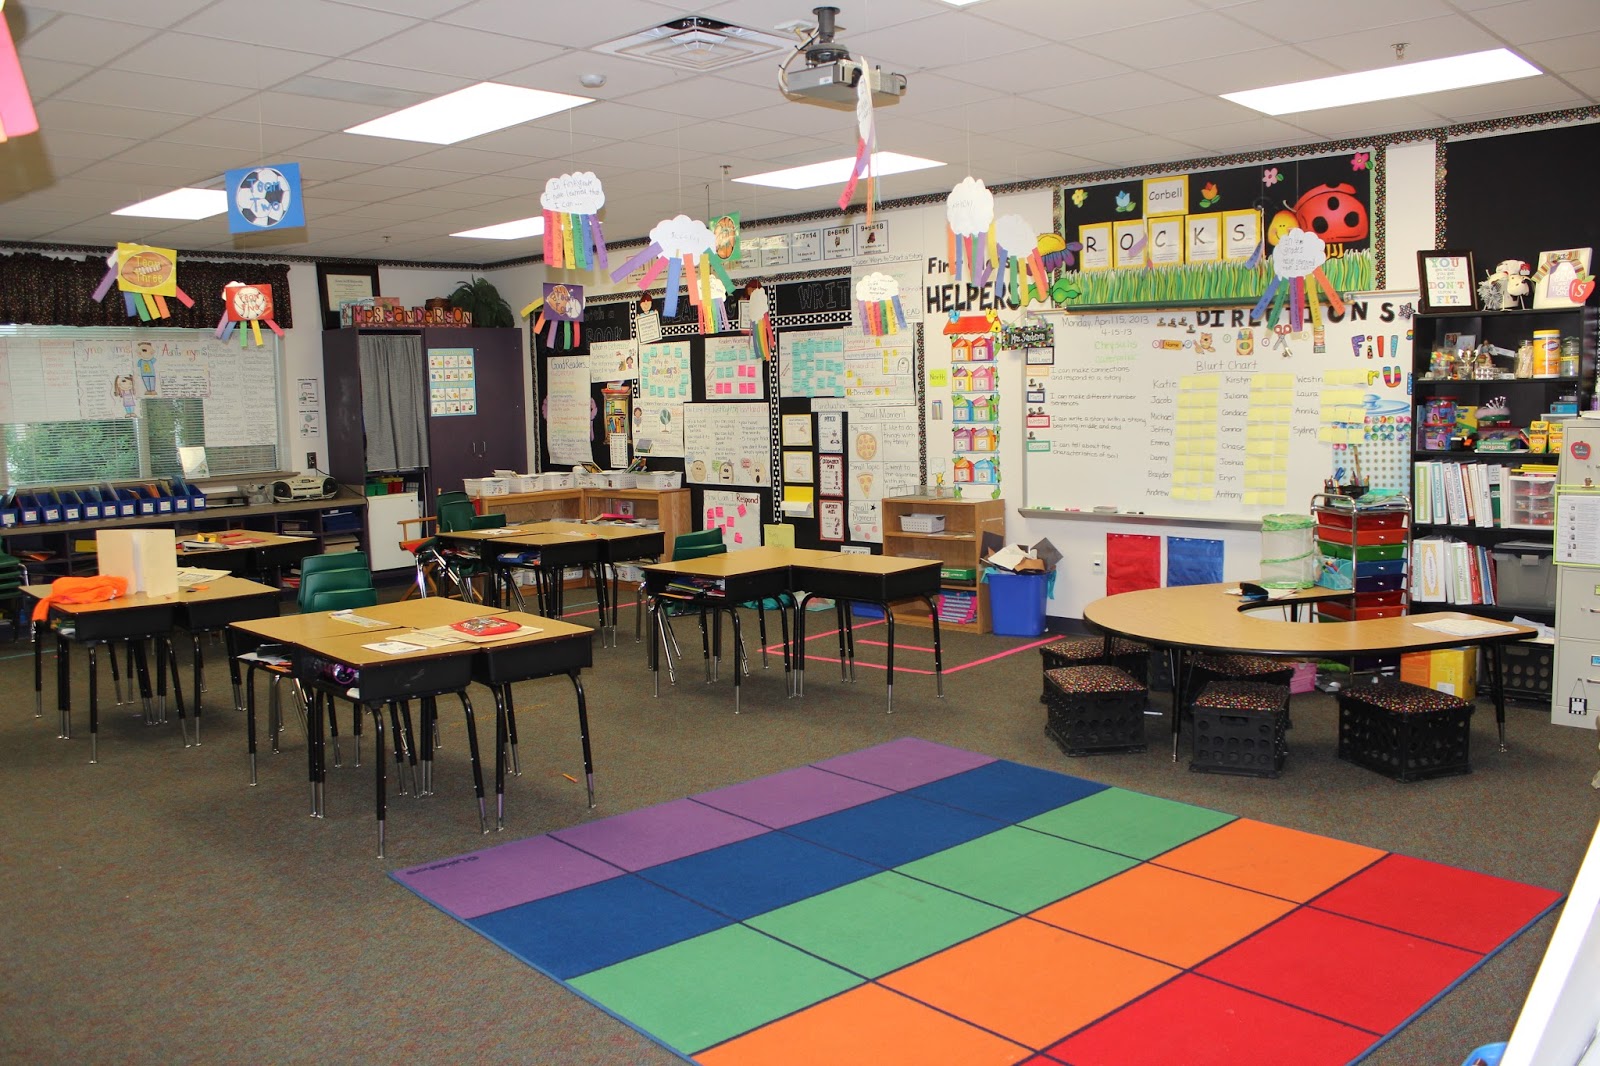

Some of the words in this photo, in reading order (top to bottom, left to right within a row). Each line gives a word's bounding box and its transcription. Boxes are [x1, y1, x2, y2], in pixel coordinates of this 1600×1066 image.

[247, 178, 282, 192] Team
[1149, 187, 1183, 200] Corbell
[250, 197, 280, 212] Two
[827, 227, 850, 236] 8+8=16
[1430, 257, 1459, 268] YOU
[1429, 281, 1465, 290] DON'T
[1573, 282, 1588, 298] S
[926, 281, 1021, 315] HELPERS
[1437, 295, 1460, 304] FIT.
[1196, 297, 1396, 329] DIREIONS
[1128, 315, 1150, 325] 2013
[1101, 328, 1133, 336] 4-15-13
[1352, 334, 1398, 360] Fill
[551, 358, 566, 369] Good
[1196, 360, 1223, 372] Blurt
[1228, 360, 1259, 371] Chart
[1063, 374, 1087, 382] respond
[1296, 376, 1323, 384] Westin
[1153, 380, 1177, 389] Katie
[1150, 396, 1173, 404] Jacob
[1224, 392, 1248, 400] Juliana
[859, 409, 878, 420] Small
[880, 409, 906, 418] Moment
[1221, 409, 1248, 417] Candace
[1295, 407, 1319, 416] Annika
[1150, 413, 1175, 421] Michael
[1150, 427, 1174, 436] Jeffrey
[1293, 425, 1318, 438] Sydney
[1150, 439, 1170, 447] Emma
[1222, 442, 1246, 451] Chase
[1150, 454, 1168, 464] Danny
[1219, 457, 1244, 466] Joshua
[850, 462, 865, 470] Small
[865, 462, 880, 471] Topic
[1148, 470, 1172, 480] Brayden
[1219, 474, 1237, 483] Eryn
[1146, 488, 1170, 497] Andrew
[1216, 490, 1243, 500] Anthony
[736, 493, 759, 506] Respond
[850, 502, 869, 513] Small
[852, 513, 877, 521] Moment
